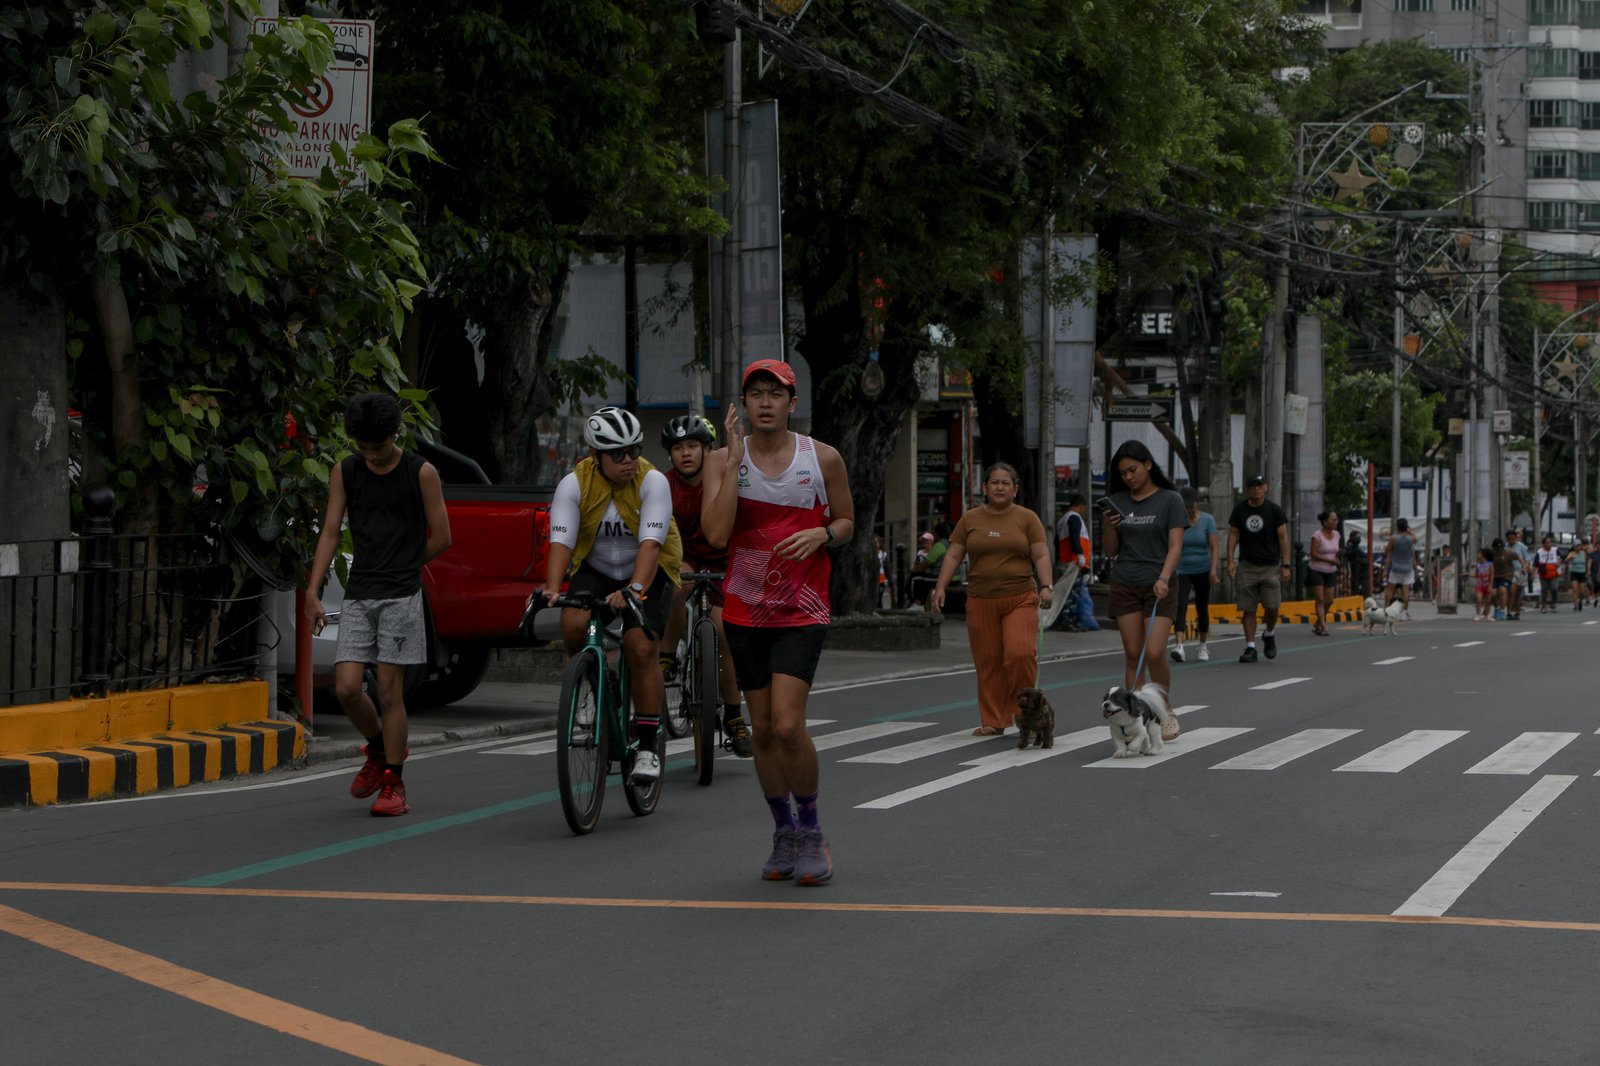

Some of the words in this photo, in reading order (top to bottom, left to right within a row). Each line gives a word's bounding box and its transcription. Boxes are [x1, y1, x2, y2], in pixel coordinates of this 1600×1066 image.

[261, 22, 280, 33] TO
[332, 25, 364, 38] ZONE
[286, 142, 331, 153] ALONG
[551, 525, 567, 533] VMS
[646, 521, 663, 529] VMS
